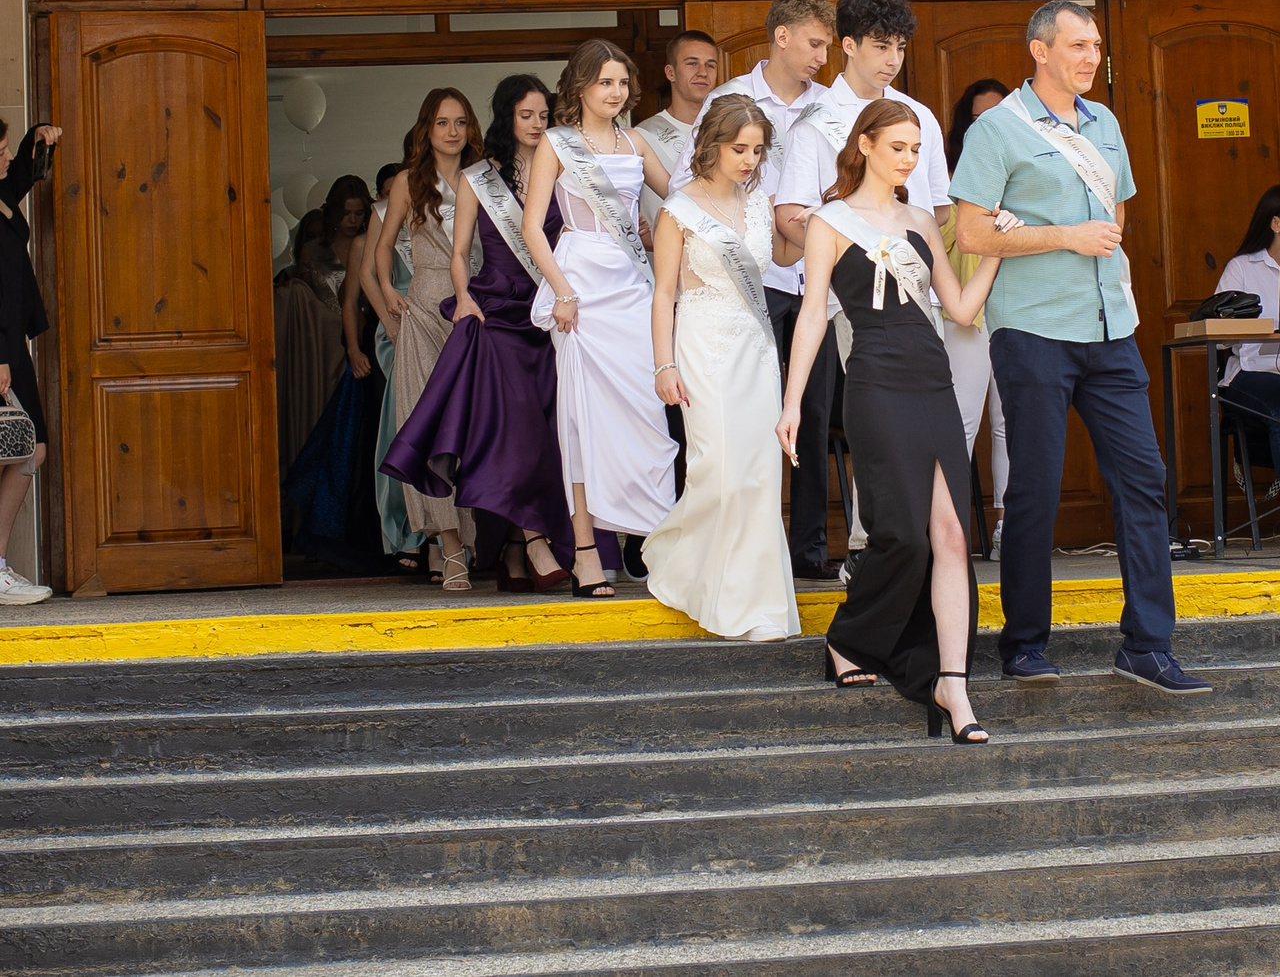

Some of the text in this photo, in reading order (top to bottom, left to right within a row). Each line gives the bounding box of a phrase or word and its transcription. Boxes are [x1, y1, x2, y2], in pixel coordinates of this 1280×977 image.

[1204, 115, 1241, 123] ТЕРМІНОВИЙ
[569, 148, 622, 223] Випускниця
[618, 220, 648, 265] 2025
